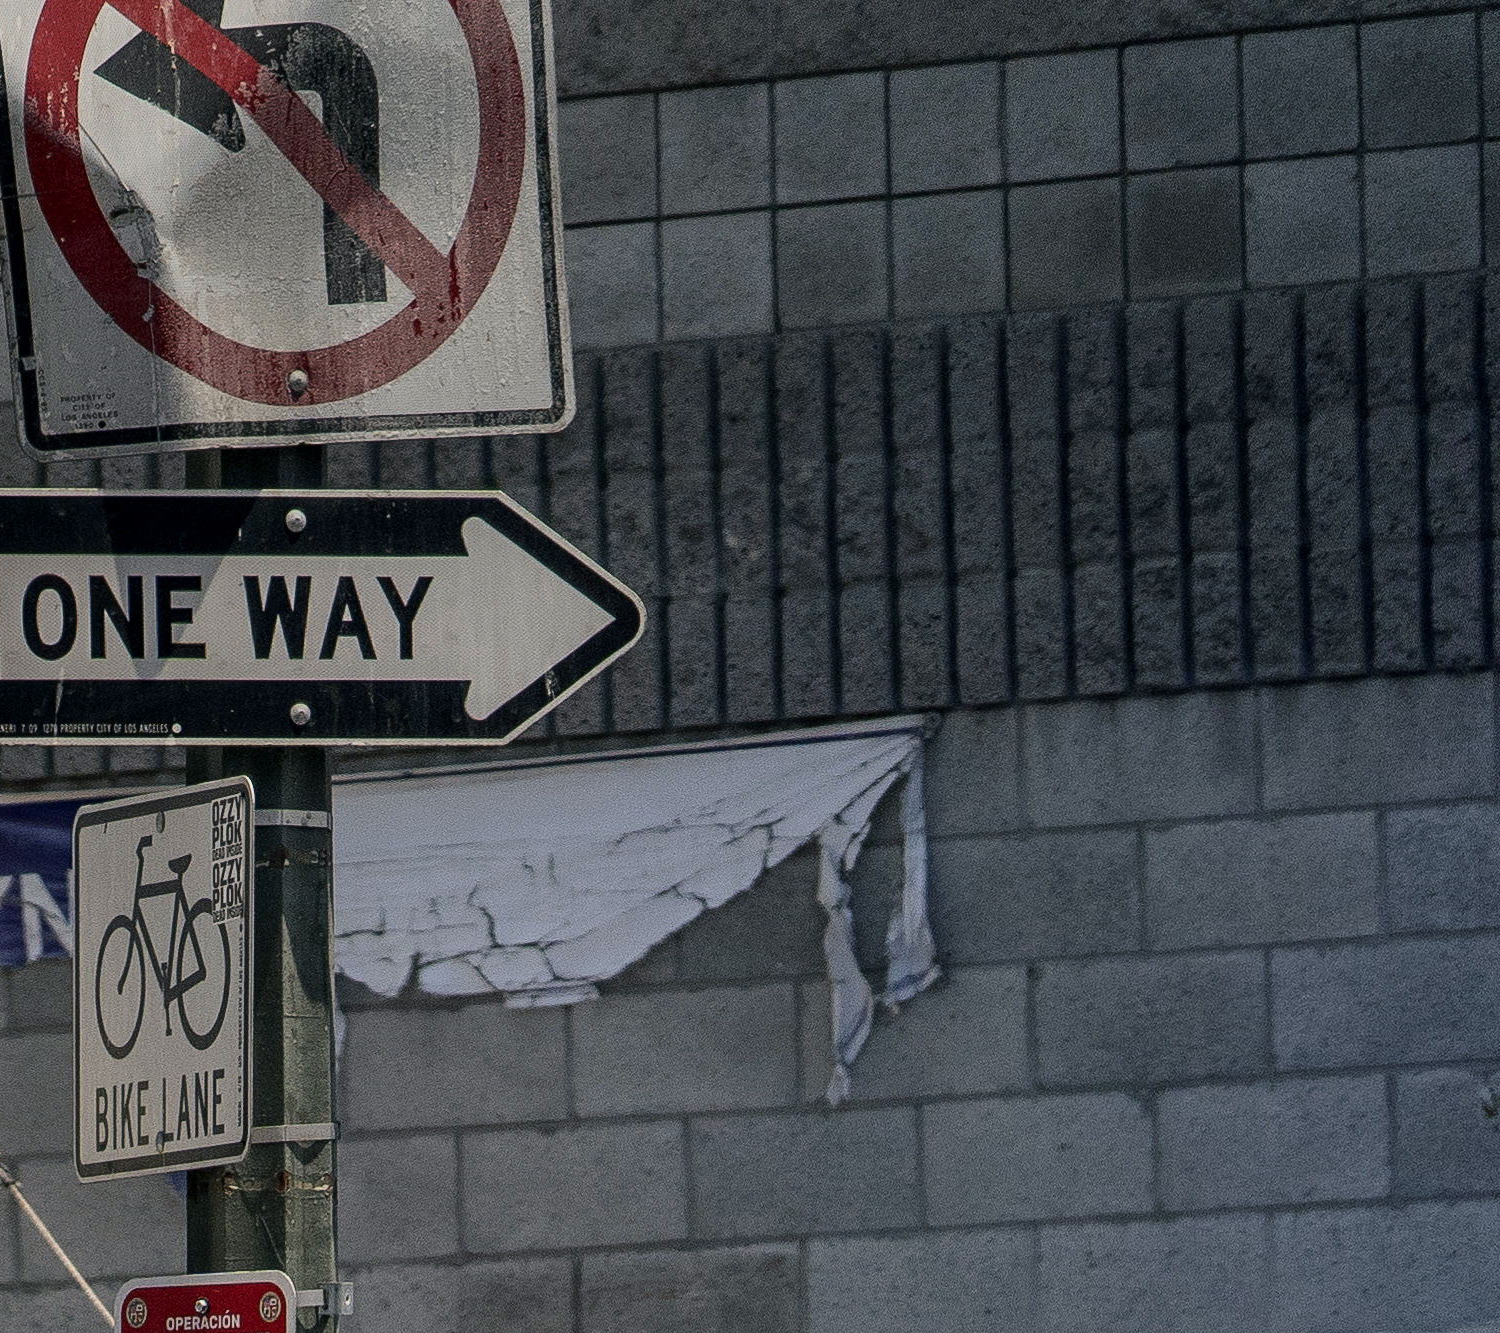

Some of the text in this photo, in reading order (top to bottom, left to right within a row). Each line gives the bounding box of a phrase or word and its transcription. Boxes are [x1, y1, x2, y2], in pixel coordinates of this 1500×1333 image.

[22, 574, 434, 661] ONE WAY
[60, 724, 94, 733] PROPERTY
[97, 724, 112, 733] CITY
[114, 724, 122, 733] OF
[124, 724, 137, 733] LOS
[139, 724, 168, 733] ANGELES
[212, 796, 241, 826] OZZY
[212, 820, 242, 849] PLOK
[213, 857, 242, 888] OZZY
[213, 882, 242, 910] PLOK
[96, 1068, 225, 1152] BIKE LANE
[166, 1310, 241, 1331] OPERACIÓN
